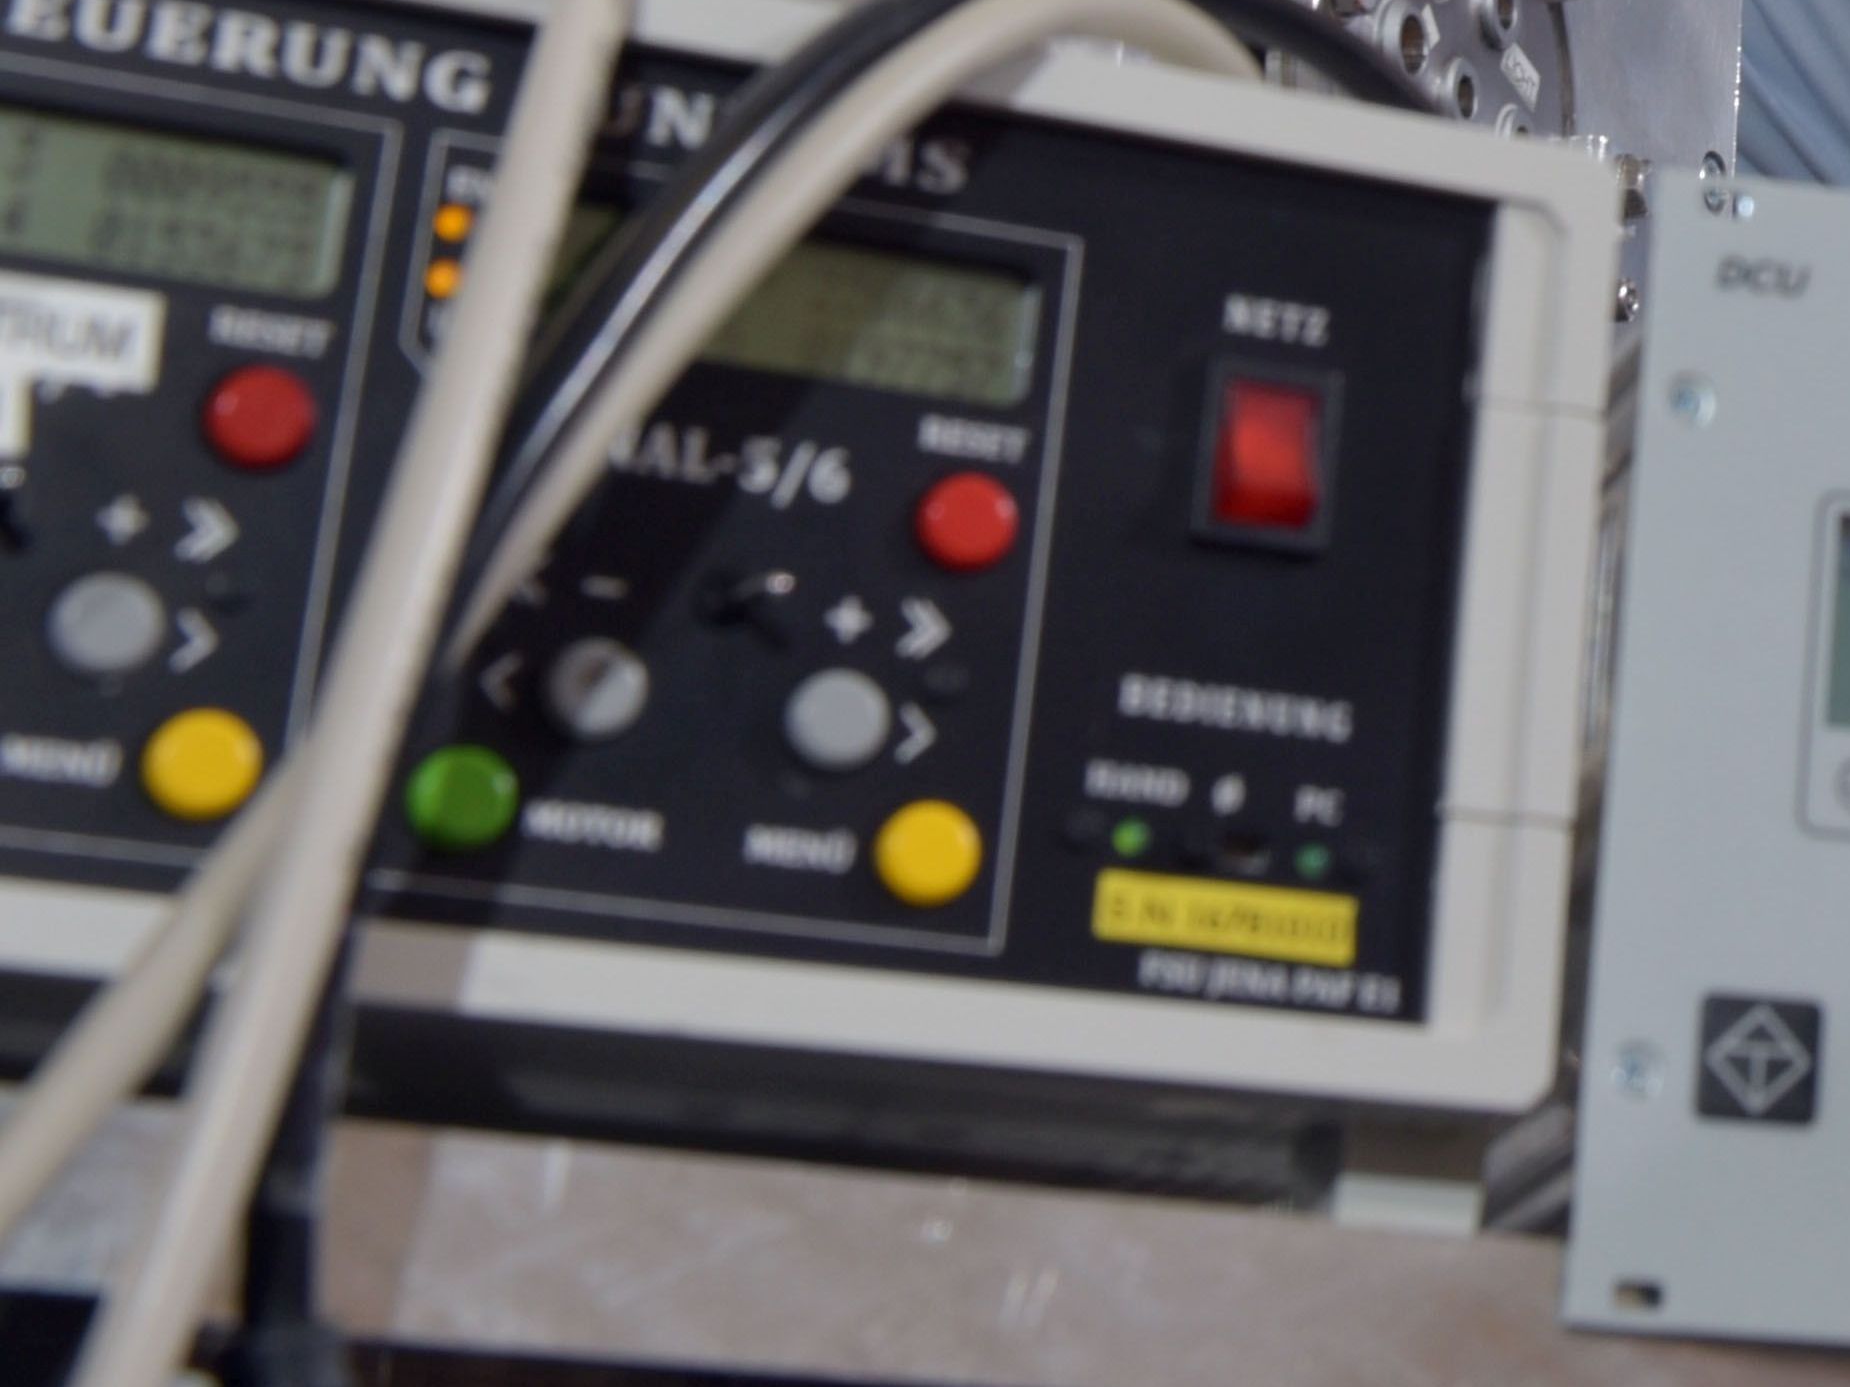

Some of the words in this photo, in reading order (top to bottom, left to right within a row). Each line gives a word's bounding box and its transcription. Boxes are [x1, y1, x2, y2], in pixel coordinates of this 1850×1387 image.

[1715, 254, 1813, 300] DCU
[208, 303, 336, 360] RESET
[1221, 291, 1331, 348] NETZ
[917, 413, 1032, 464] RESET
[1118, 672, 1354, 745] BEDIENUNG
[1084, 758, 1191, 808] HAND
[1294, 783, 1345, 829] PC
[521, 797, 664, 854] MOTOR
[742, 823, 858, 877] MENÜ
